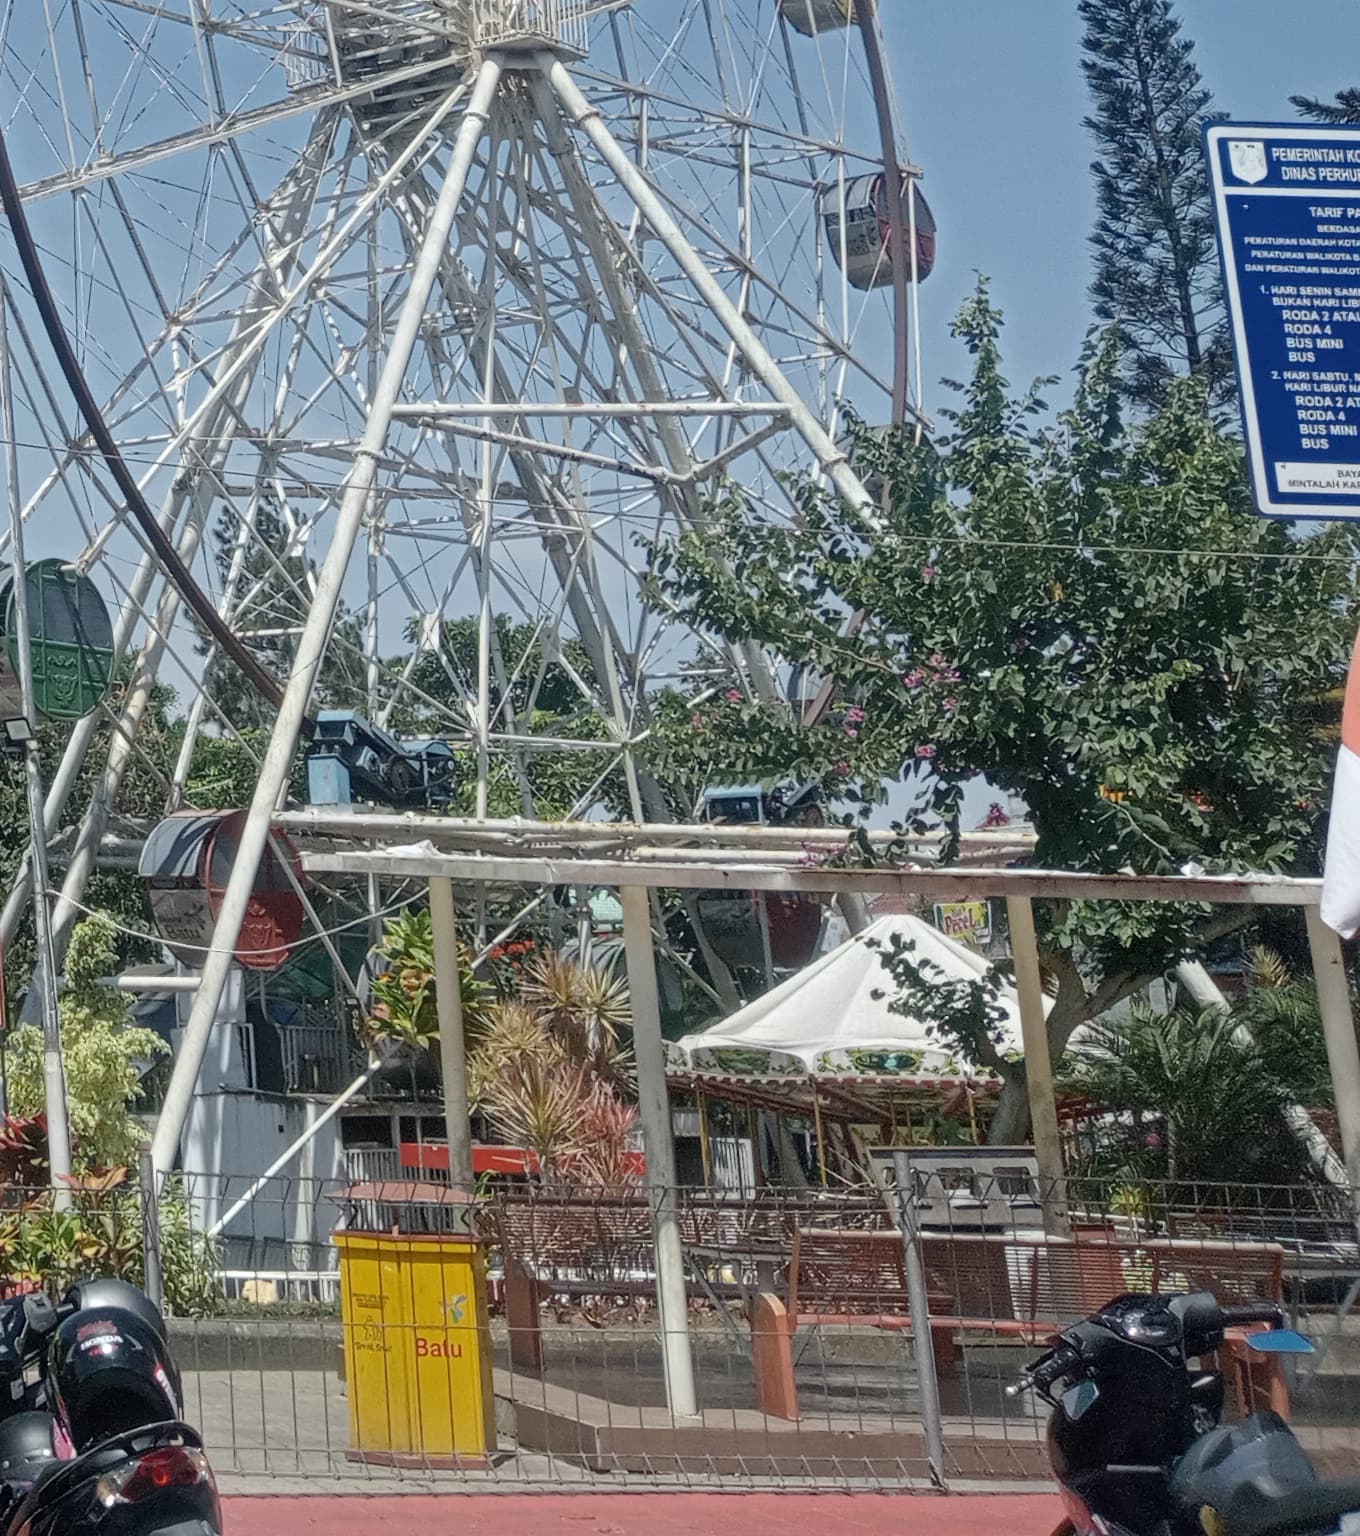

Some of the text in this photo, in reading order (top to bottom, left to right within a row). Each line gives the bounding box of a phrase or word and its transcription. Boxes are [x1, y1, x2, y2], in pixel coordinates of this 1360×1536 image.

[1271, 147, 1345, 163] PEMERINTAH
[1281, 166, 1317, 181] DINAS
[1308, 206, 1345, 218] TARIF
[1243, 236, 1298, 245] PERATURAN
[1299, 237, 1337, 247] DAERAH
[1251, 250, 1305, 260] PERATURAN
[1305, 252, 1352, 261] WALIKOTA
[1244, 263, 1265, 272] DAN
[1265, 265, 1320, 274] PERATURAN
[1270, 285, 1298, 295] HARI
[1299, 286, 1332, 296] SENIN
[1272, 296, 1311, 306] BUKAN
[1312, 298, 1340, 307] HARI
[1282, 309, 1320, 321] RODA
[1322, 311, 1330, 322] 2
[1284, 323, 1332, 335] RODA 4
[1286, 337, 1344, 350] BUS MINI
[1289, 351, 1316, 363] BUS
[1283, 370, 1310, 381] HARI
[1285, 382, 1312, 392] HARI
[1313, 383, 1347, 393] LIBUR
[1295, 395, 1334, 407] RODA
[1335, 396, 1344, 408] 2
[1297, 409, 1346, 422] RODA 4
[1299, 423, 1358, 436] BUS MINI
[1301, 437, 1330, 450] BUS
[1288, 479, 1340, 489] MINTALAH
[80, 1335, 124, 1351] HONDA
[415, 1337, 463, 1359] Batu
